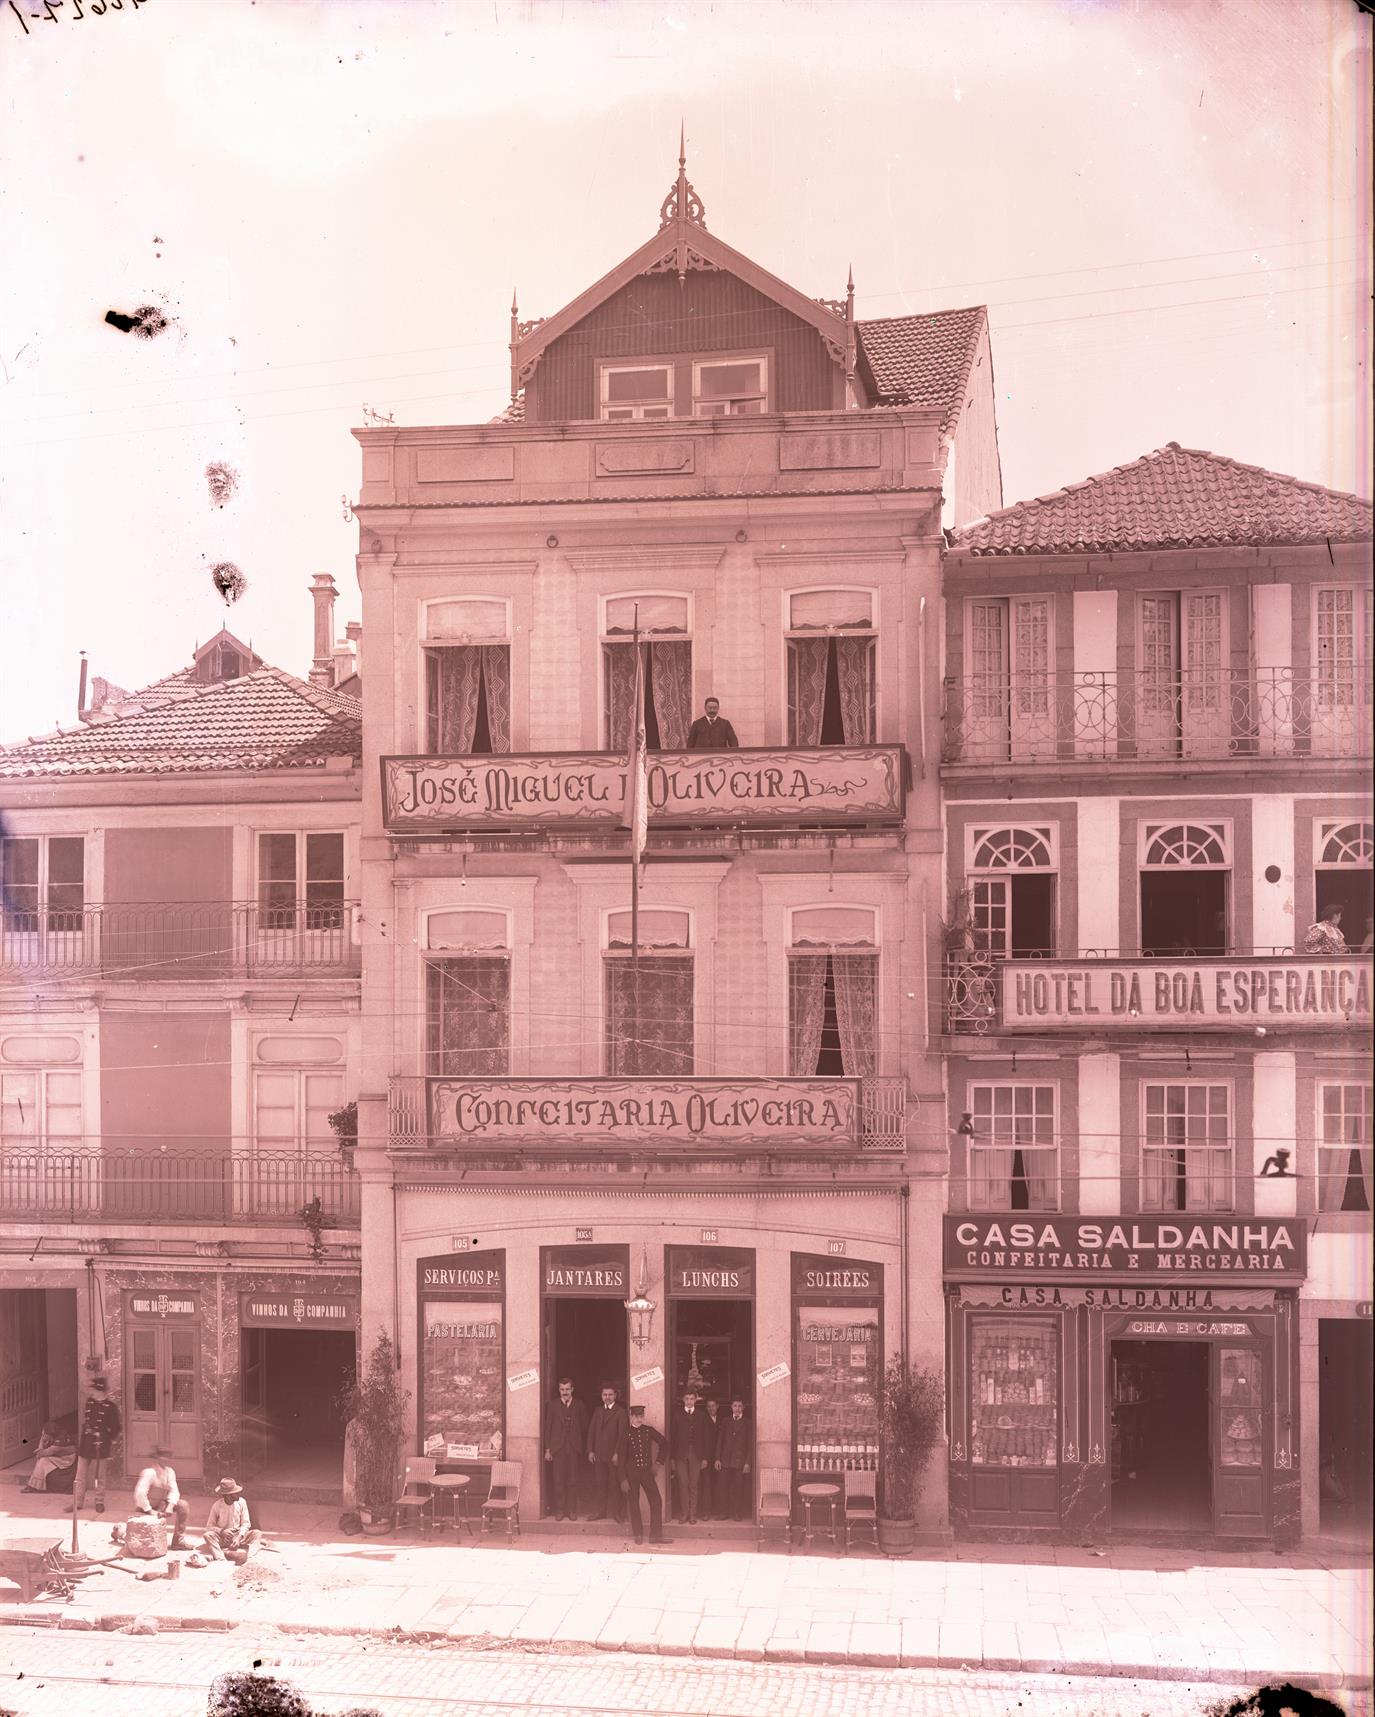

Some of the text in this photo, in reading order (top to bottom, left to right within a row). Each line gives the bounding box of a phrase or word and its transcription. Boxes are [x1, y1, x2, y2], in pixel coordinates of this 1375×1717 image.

[485, 768, 609, 811] MIGUEL
[1016, 970, 1371, 1019] HOTEL DA BOA ESPERANÇA
[455, 1092, 845, 1133] CONFEITARIA OLIVEIRA
[454, 1238, 468, 1249] 105
[702, 1231, 717, 1241] 106
[956, 1222, 1295, 1250] CASA SALDANHA
[830, 1242, 844, 1252] 107
[967, 1251, 1285, 1270] CONFEITARIA E MERCEARIA
[424, 1268, 484, 1287] SERVIÇOS
[546, 1270, 622, 1287] JANTARES
[682, 1271, 739, 1288] LUNCHS
[1002, 1287, 1213, 1308] CASA SALDANHA
[252, 1303, 277, 1317] VINHOS
[279, 1304, 288, 1317] DA
[306, 1305, 346, 1318] COMPANHIA
[427, 1324, 498, 1339] PASTELARIA
[802, 1326, 873, 1342] CERVEJARIA
[1176, 1322, 1189, 1334] E
